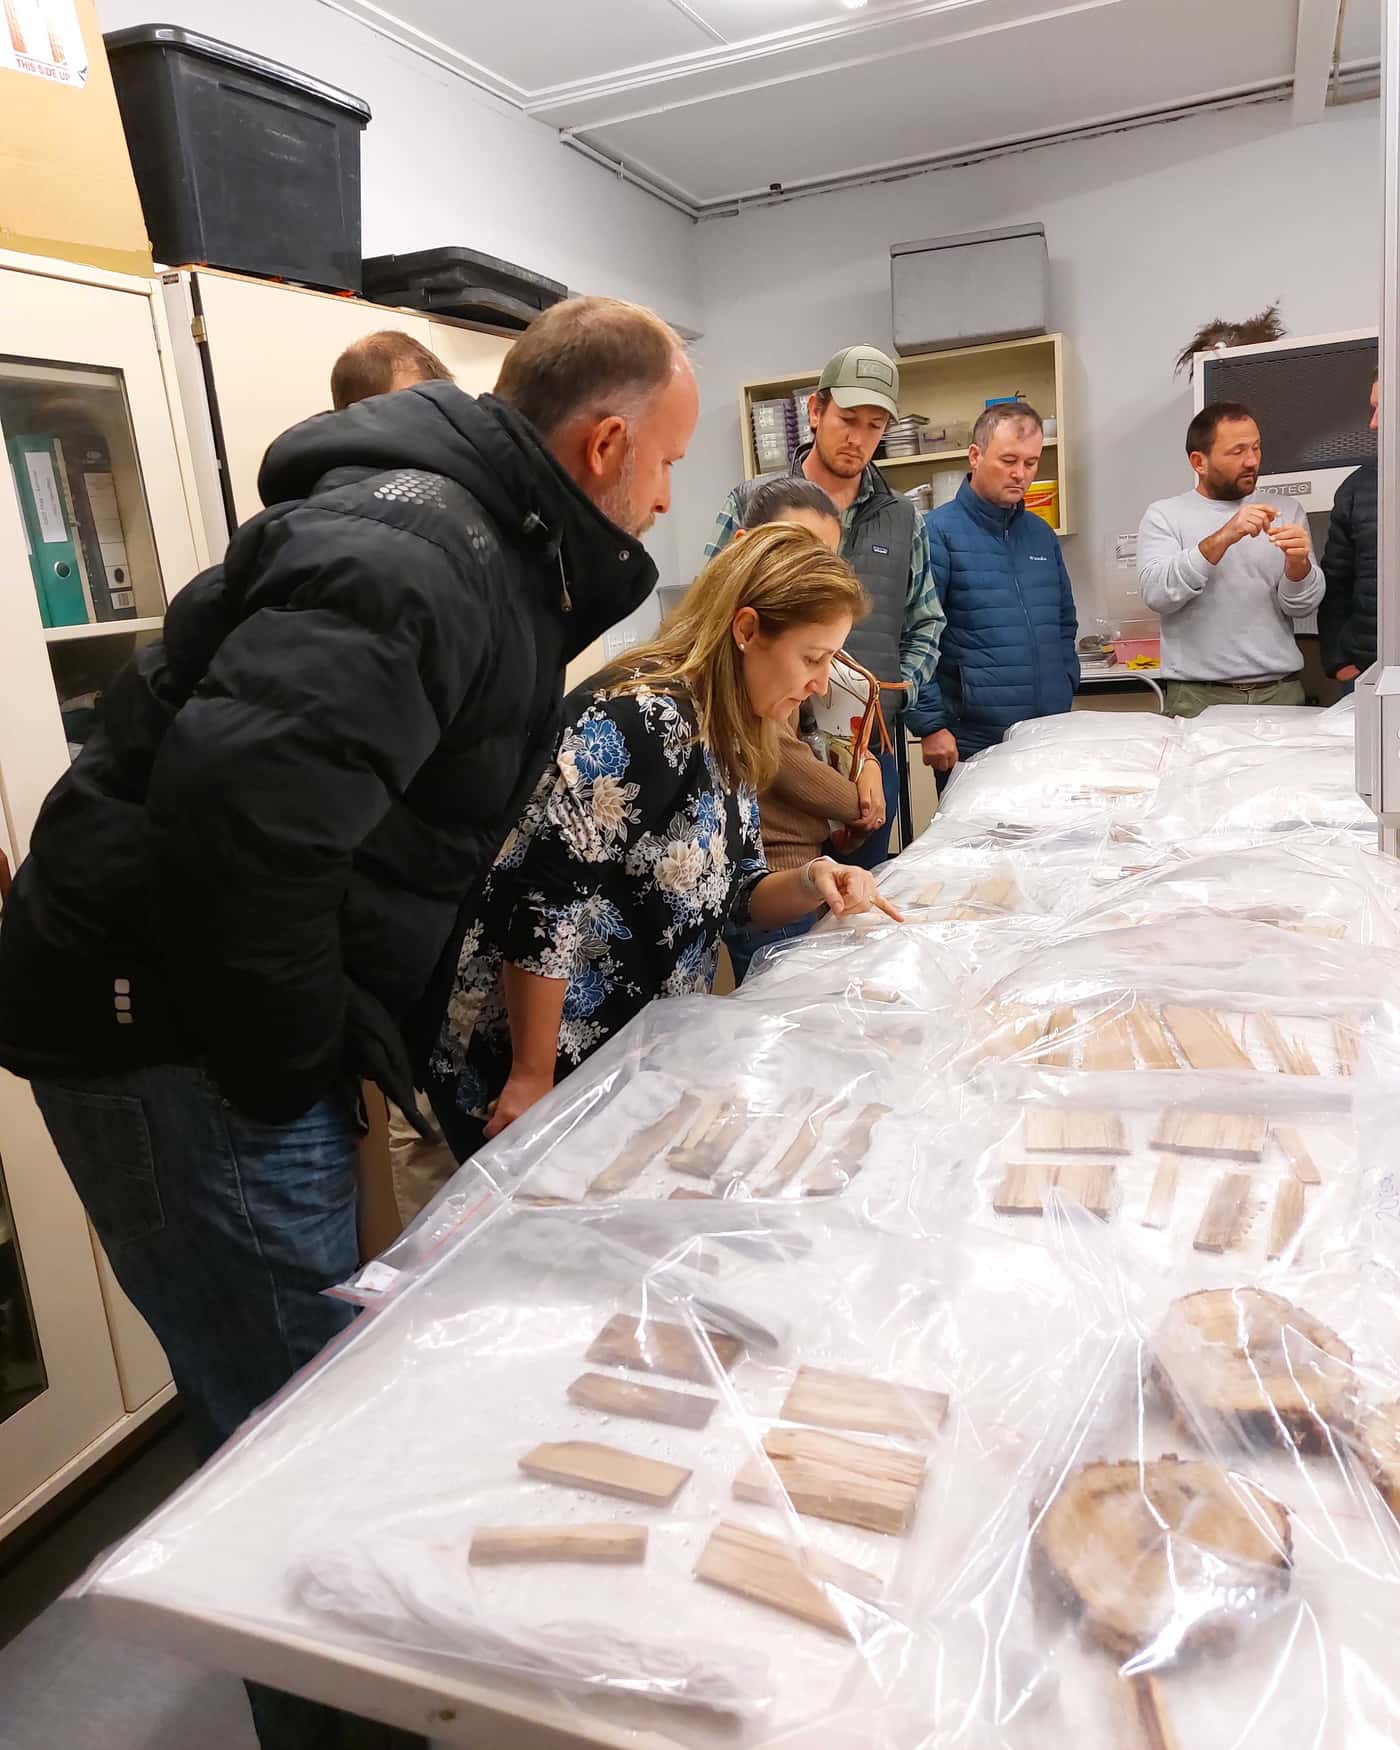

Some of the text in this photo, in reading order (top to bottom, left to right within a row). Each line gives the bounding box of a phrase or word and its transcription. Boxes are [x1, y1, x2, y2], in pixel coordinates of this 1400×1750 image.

[16, 58, 71, 81] THIS SIDE UP
